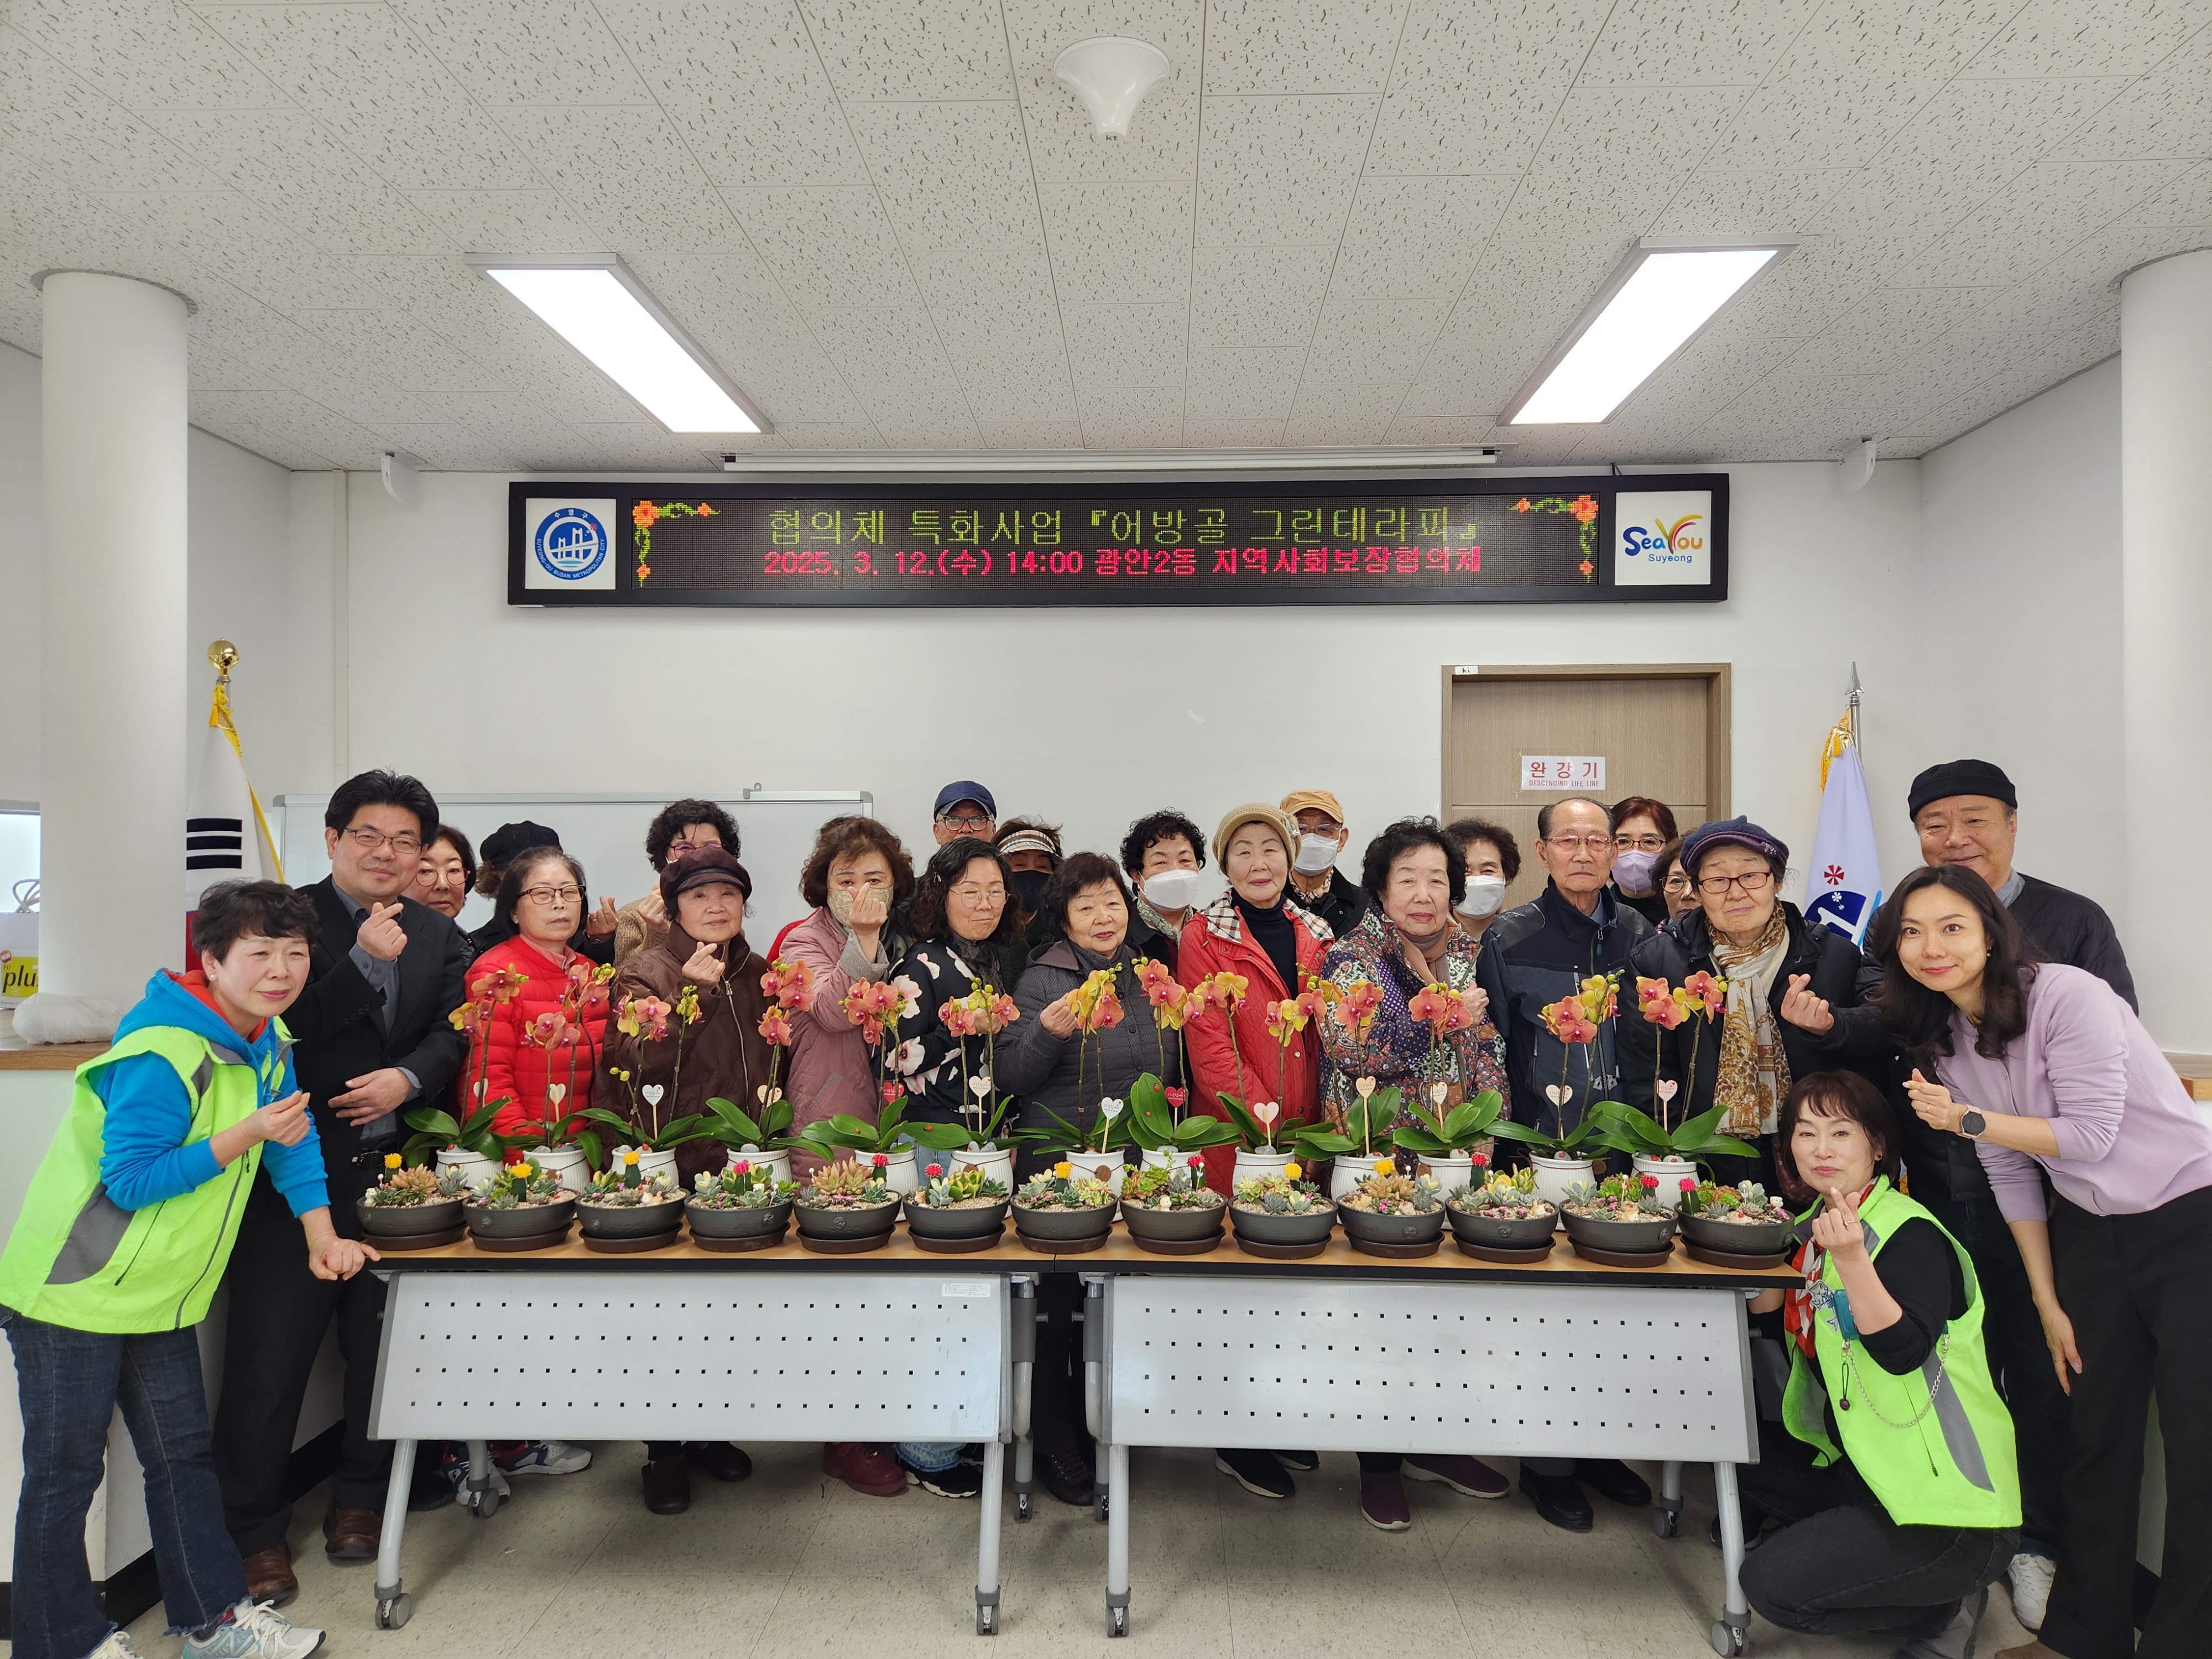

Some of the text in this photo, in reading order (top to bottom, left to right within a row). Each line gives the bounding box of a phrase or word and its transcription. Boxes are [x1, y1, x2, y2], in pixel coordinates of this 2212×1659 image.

[554, 509, 588, 519] 수영구
[769, 510, 884, 544] 협의체
[909, 509, 1061, 544] 특화사업
[536, 538, 553, 571] SUYEONG-GU
[554, 570, 571, 578] BUSAN
[573, 552, 604, 578] METROPOLITAN
[764, 546, 1481, 576] 2025. 3. 12.(수) 14:00 광안2동 지역사회보장협의체
[1648, 554, 1692, 563] Suyeong
[1530, 761, 1597, 779] 완강기
[2, 964, 38, 993] plu
